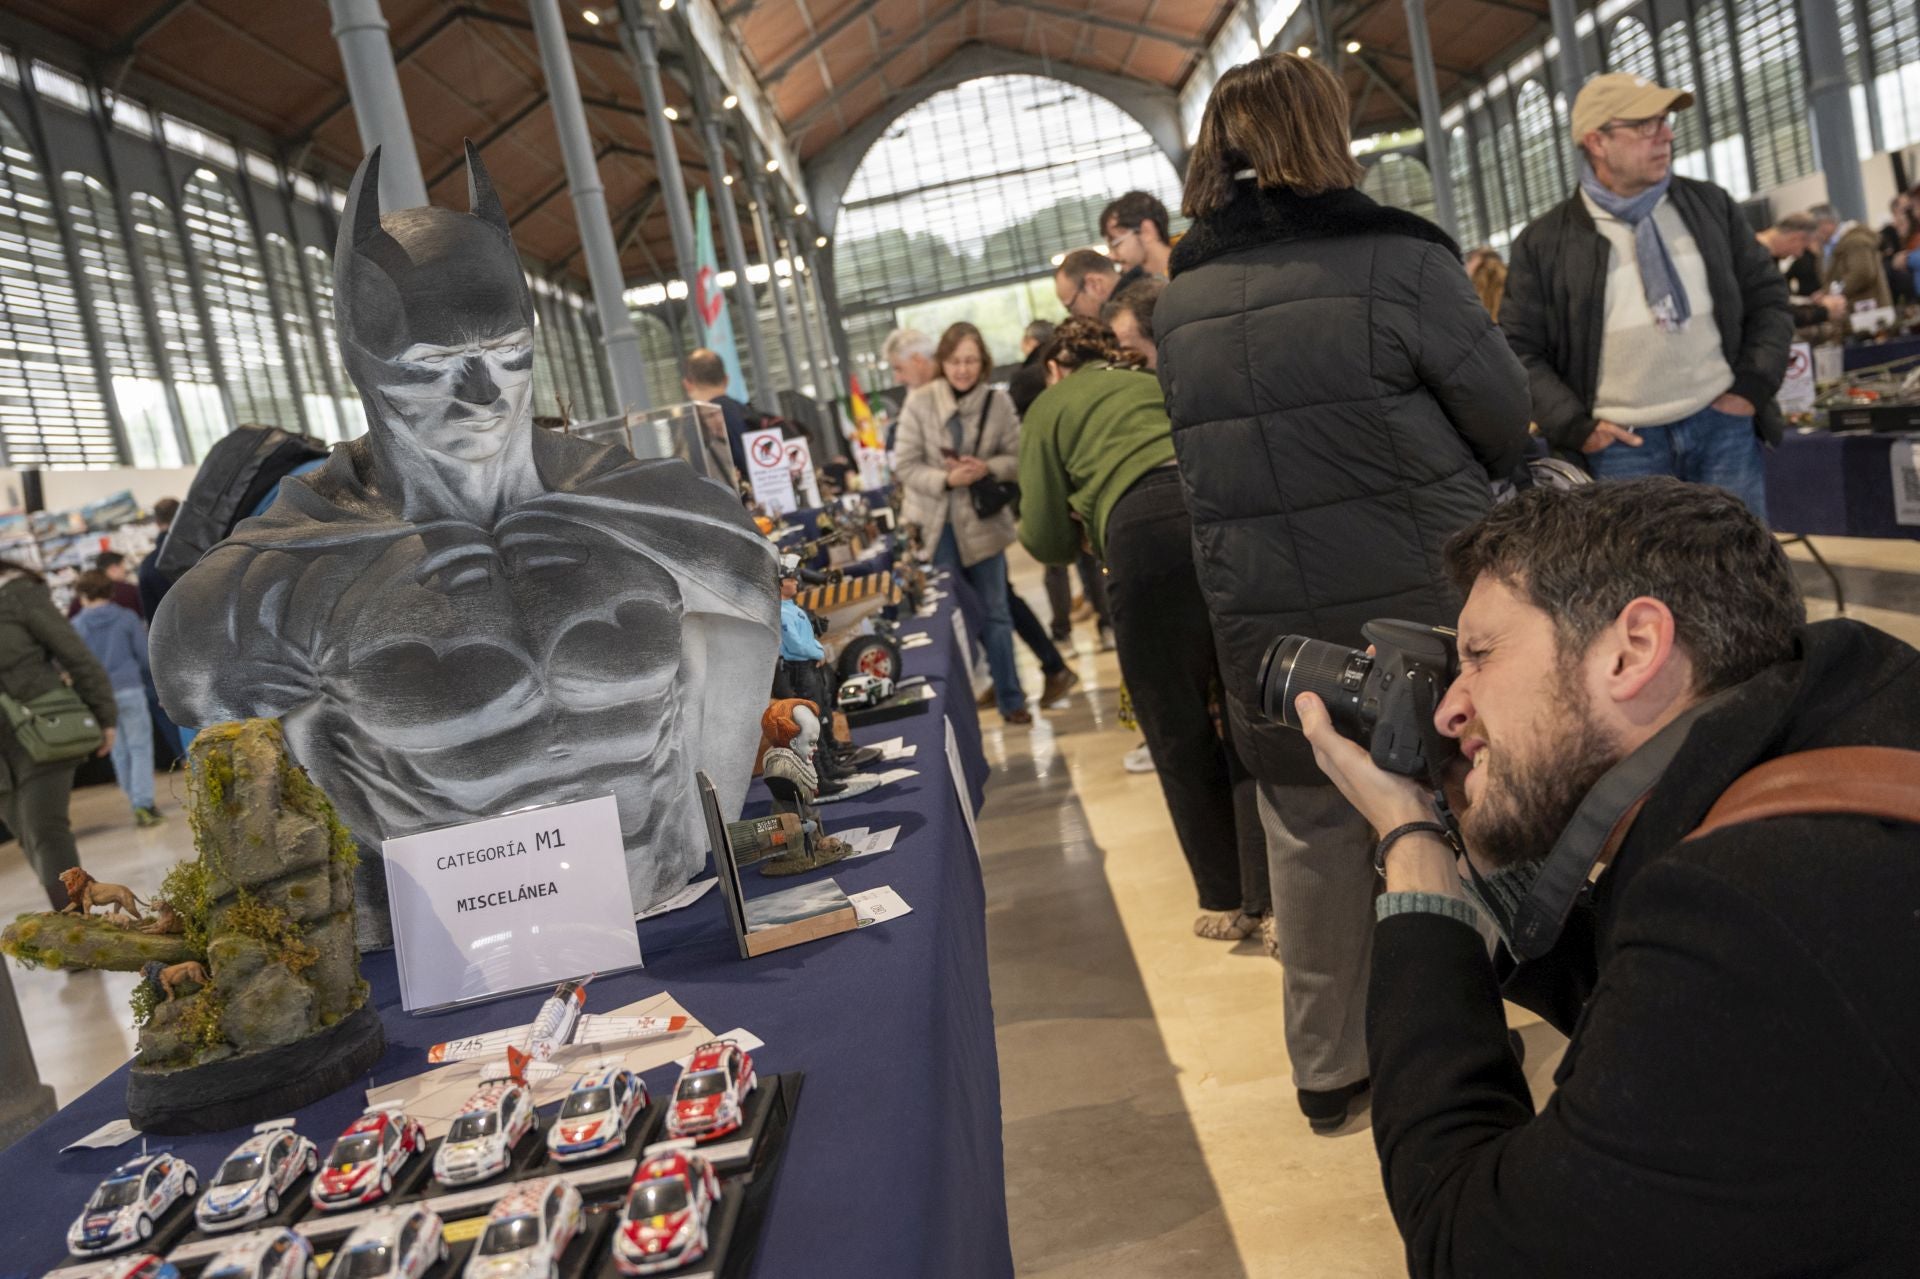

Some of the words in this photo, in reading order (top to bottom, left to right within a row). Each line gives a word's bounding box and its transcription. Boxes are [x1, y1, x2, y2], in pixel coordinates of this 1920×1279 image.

[436, 840, 528, 871] CATEGORÍA
[535, 828, 566, 851] M1
[457, 881, 559, 913] MISCELÁNEA
